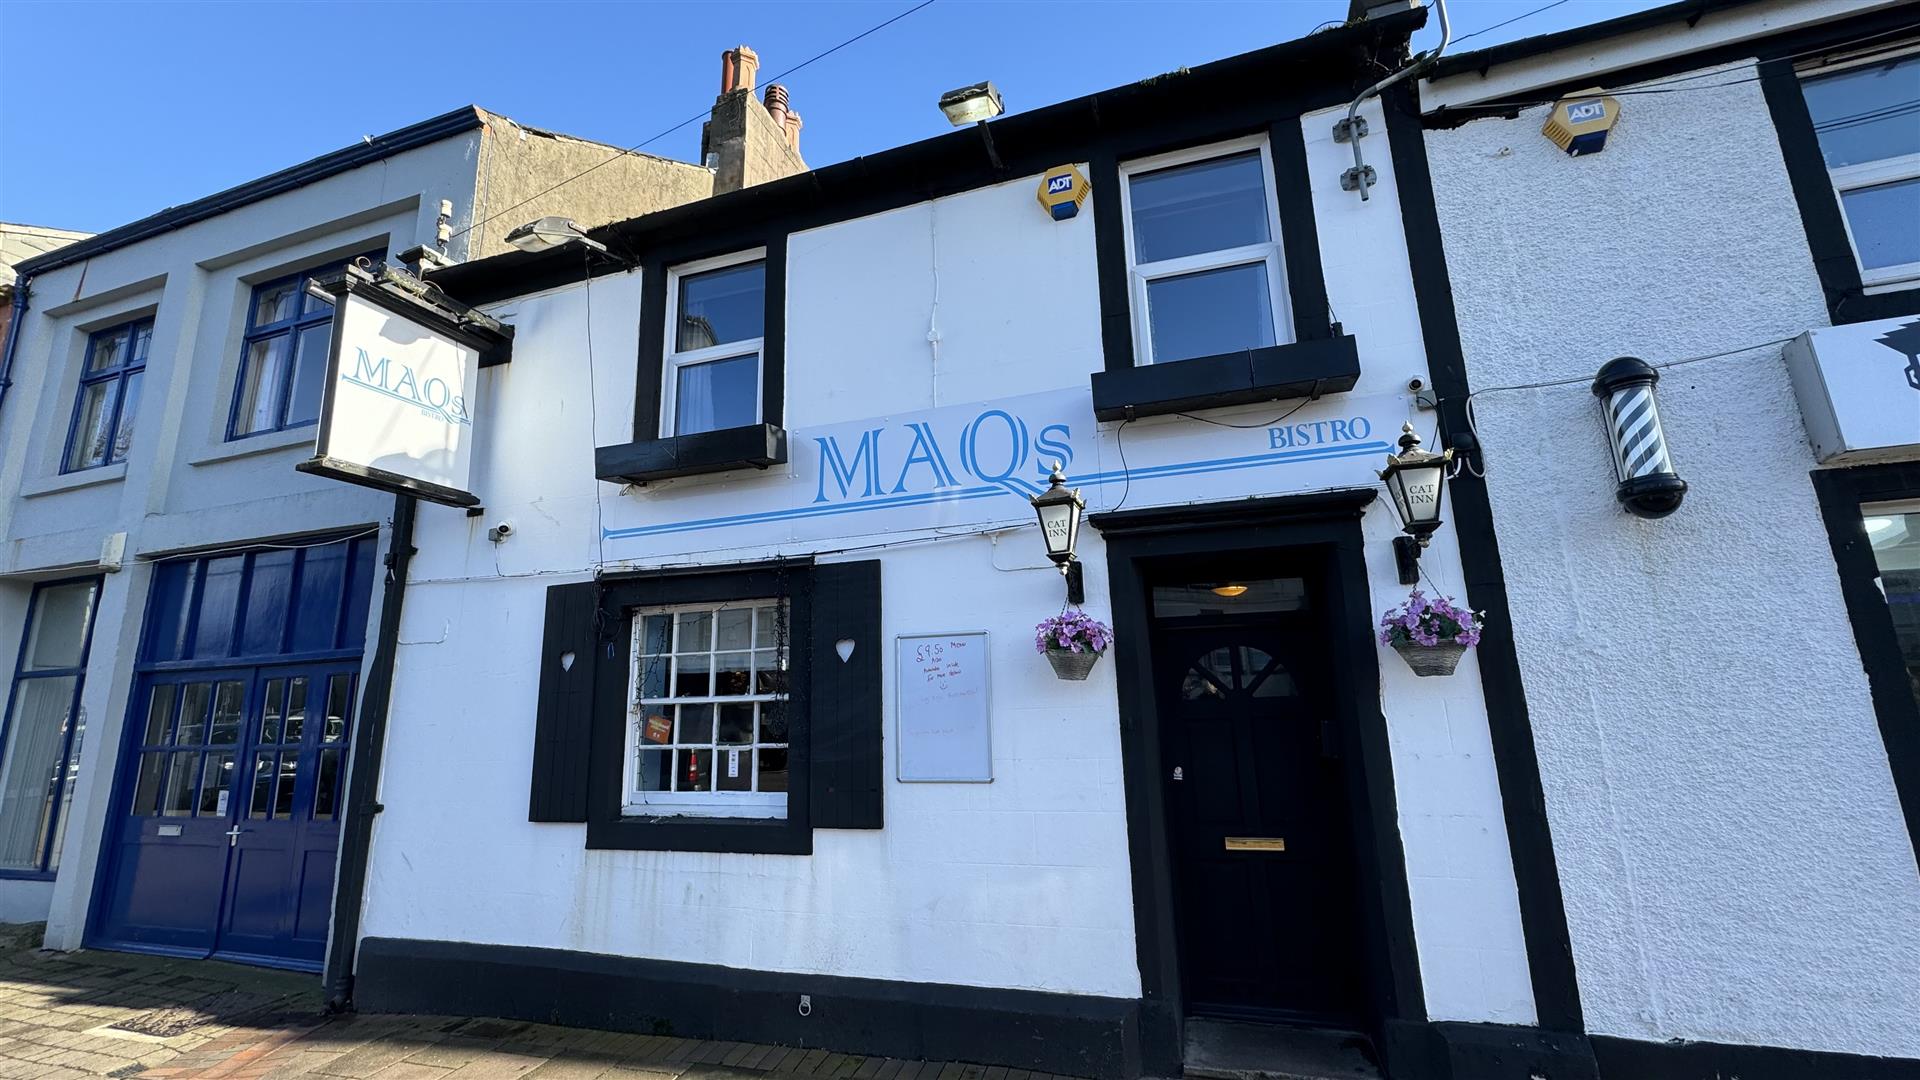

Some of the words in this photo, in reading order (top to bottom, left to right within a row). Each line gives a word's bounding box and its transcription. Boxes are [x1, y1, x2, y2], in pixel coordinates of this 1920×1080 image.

[1570, 103, 1602, 121] ADT
[1048, 176, 1073, 193] ADT
[1268, 416, 1371, 449] BISTRO
[1410, 485, 1434, 494] CAT
[1411, 494, 1434, 504] INN
[1048, 520, 1066, 528] CAT
[1048, 528, 1067, 537] INN
